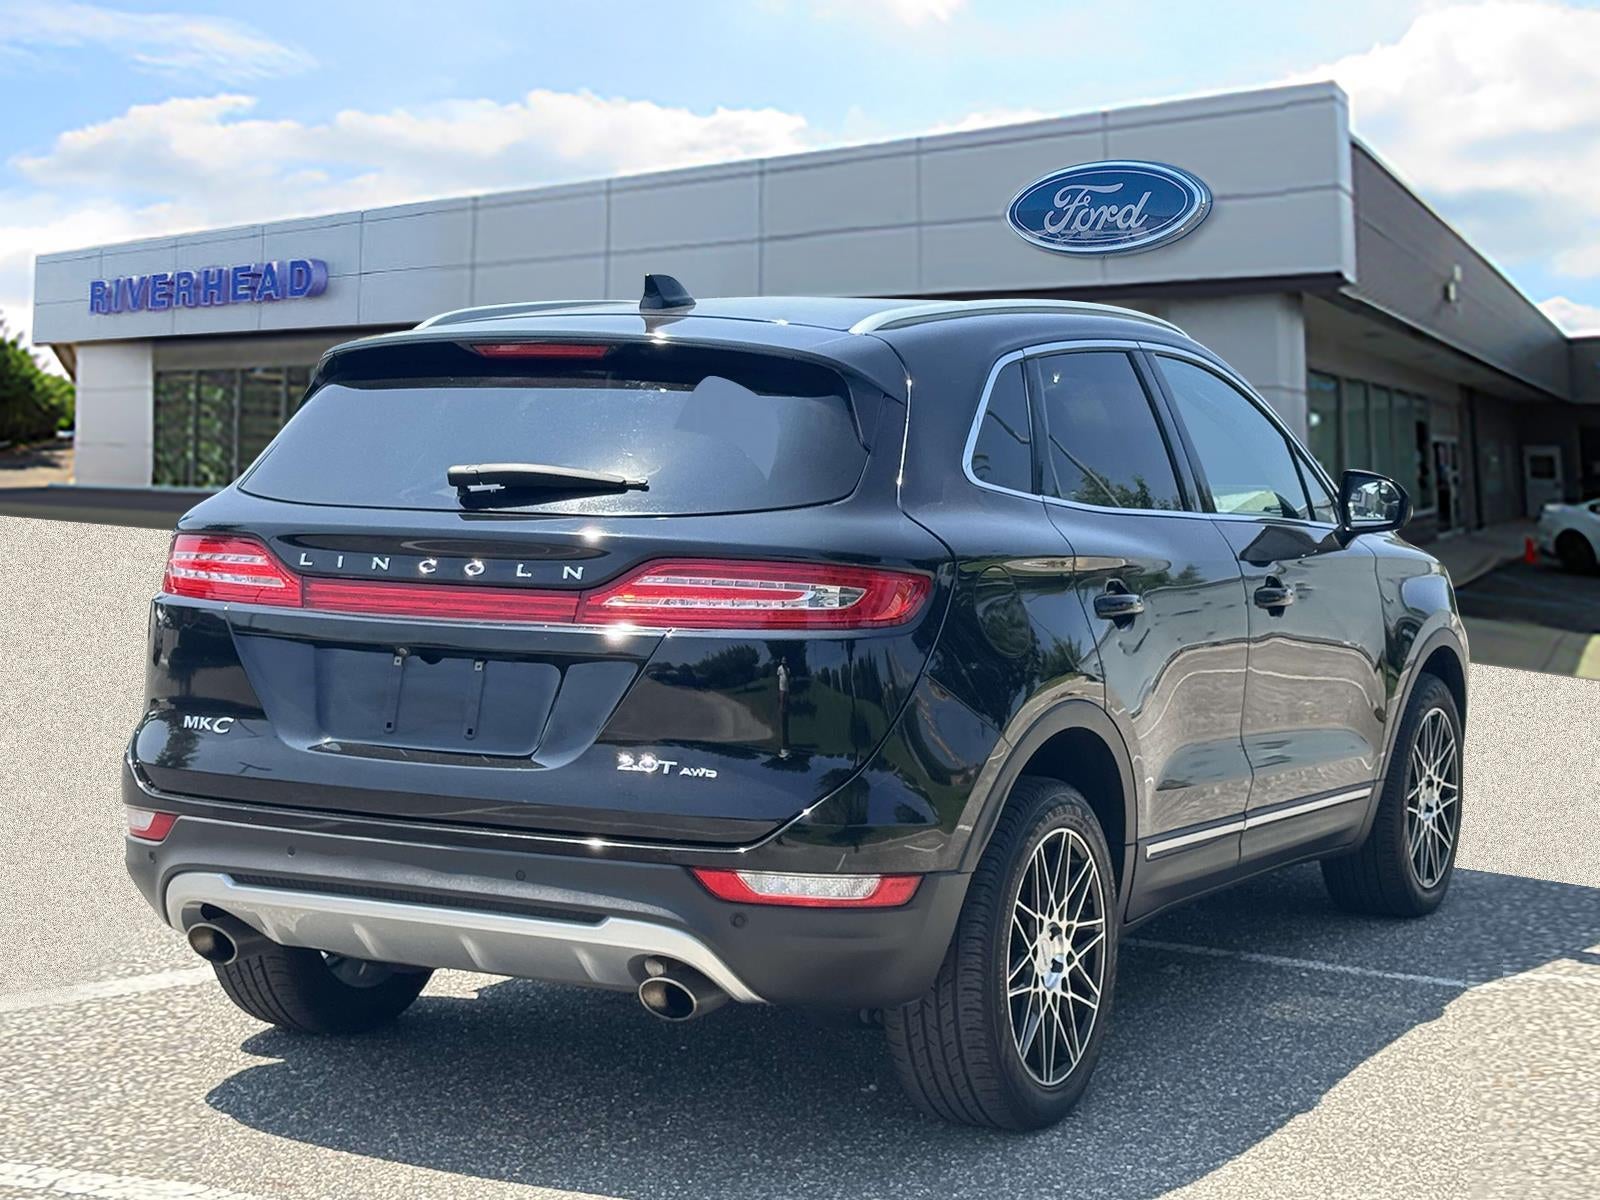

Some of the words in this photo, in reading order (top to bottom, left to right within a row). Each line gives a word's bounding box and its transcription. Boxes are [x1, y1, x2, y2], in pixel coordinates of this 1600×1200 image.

[1043, 182, 1152, 234] Ford
[89, 258, 325, 315] RIVERHEAD
[299, 552, 584, 580] LINCOLN
[183, 715, 234, 734] MKC
[616, 752, 677, 775] 2.0T
[679, 767, 717, 778] AWD
